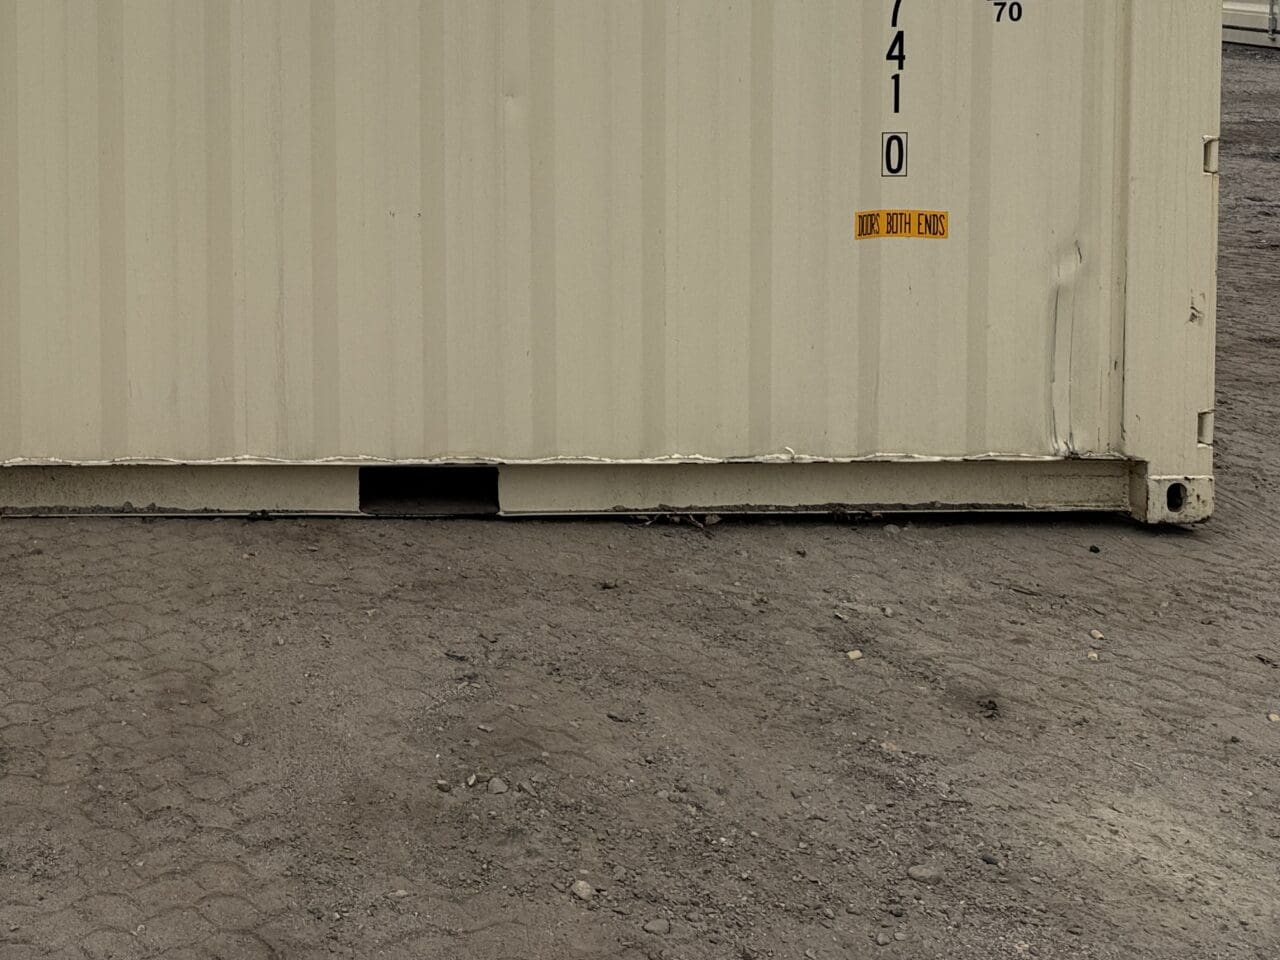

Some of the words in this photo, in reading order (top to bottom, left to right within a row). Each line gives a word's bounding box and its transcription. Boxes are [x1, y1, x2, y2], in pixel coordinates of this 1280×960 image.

[993, 1, 1023, 22] 70
[885, 135, 904, 173] 0
[885, 212, 911, 234] BOTH
[917, 213, 945, 236] ENDS
